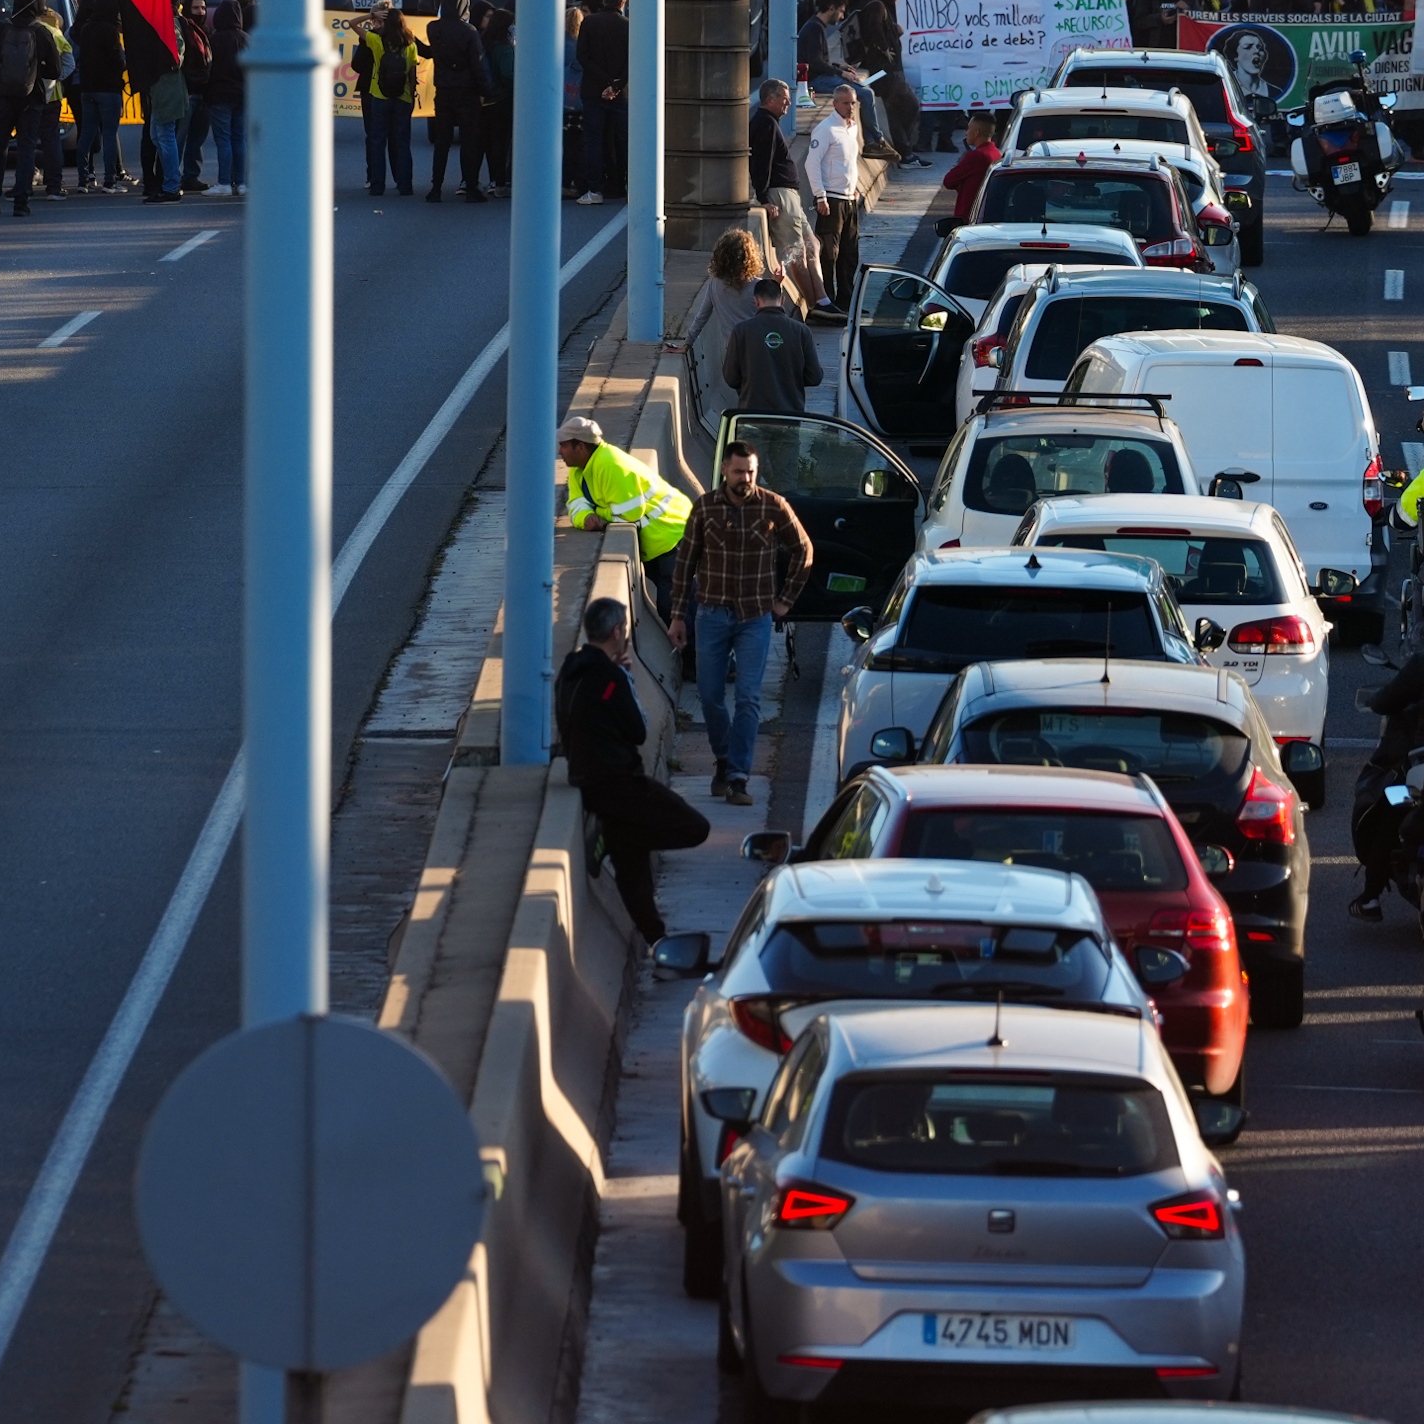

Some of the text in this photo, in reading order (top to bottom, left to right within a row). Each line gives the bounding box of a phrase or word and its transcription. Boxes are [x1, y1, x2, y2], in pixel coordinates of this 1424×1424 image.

[965, 2, 990, 27] vols
[992, 4, 1046, 27] millorar
[1220, 13, 1241, 22] ELS
[1242, 13, 1285, 23] SERVEIS
[1286, 13, 1332, 23] SOCIALS
[1333, 13, 1350, 22] DE
[1352, 13, 1367, 22] LA
[1368, 12, 1400, 22] CIUTAT
[981, 33, 998, 46] de
[1375, 60, 1410, 74] DIGNES
[940, 1315, 1009, 1343] 4745
